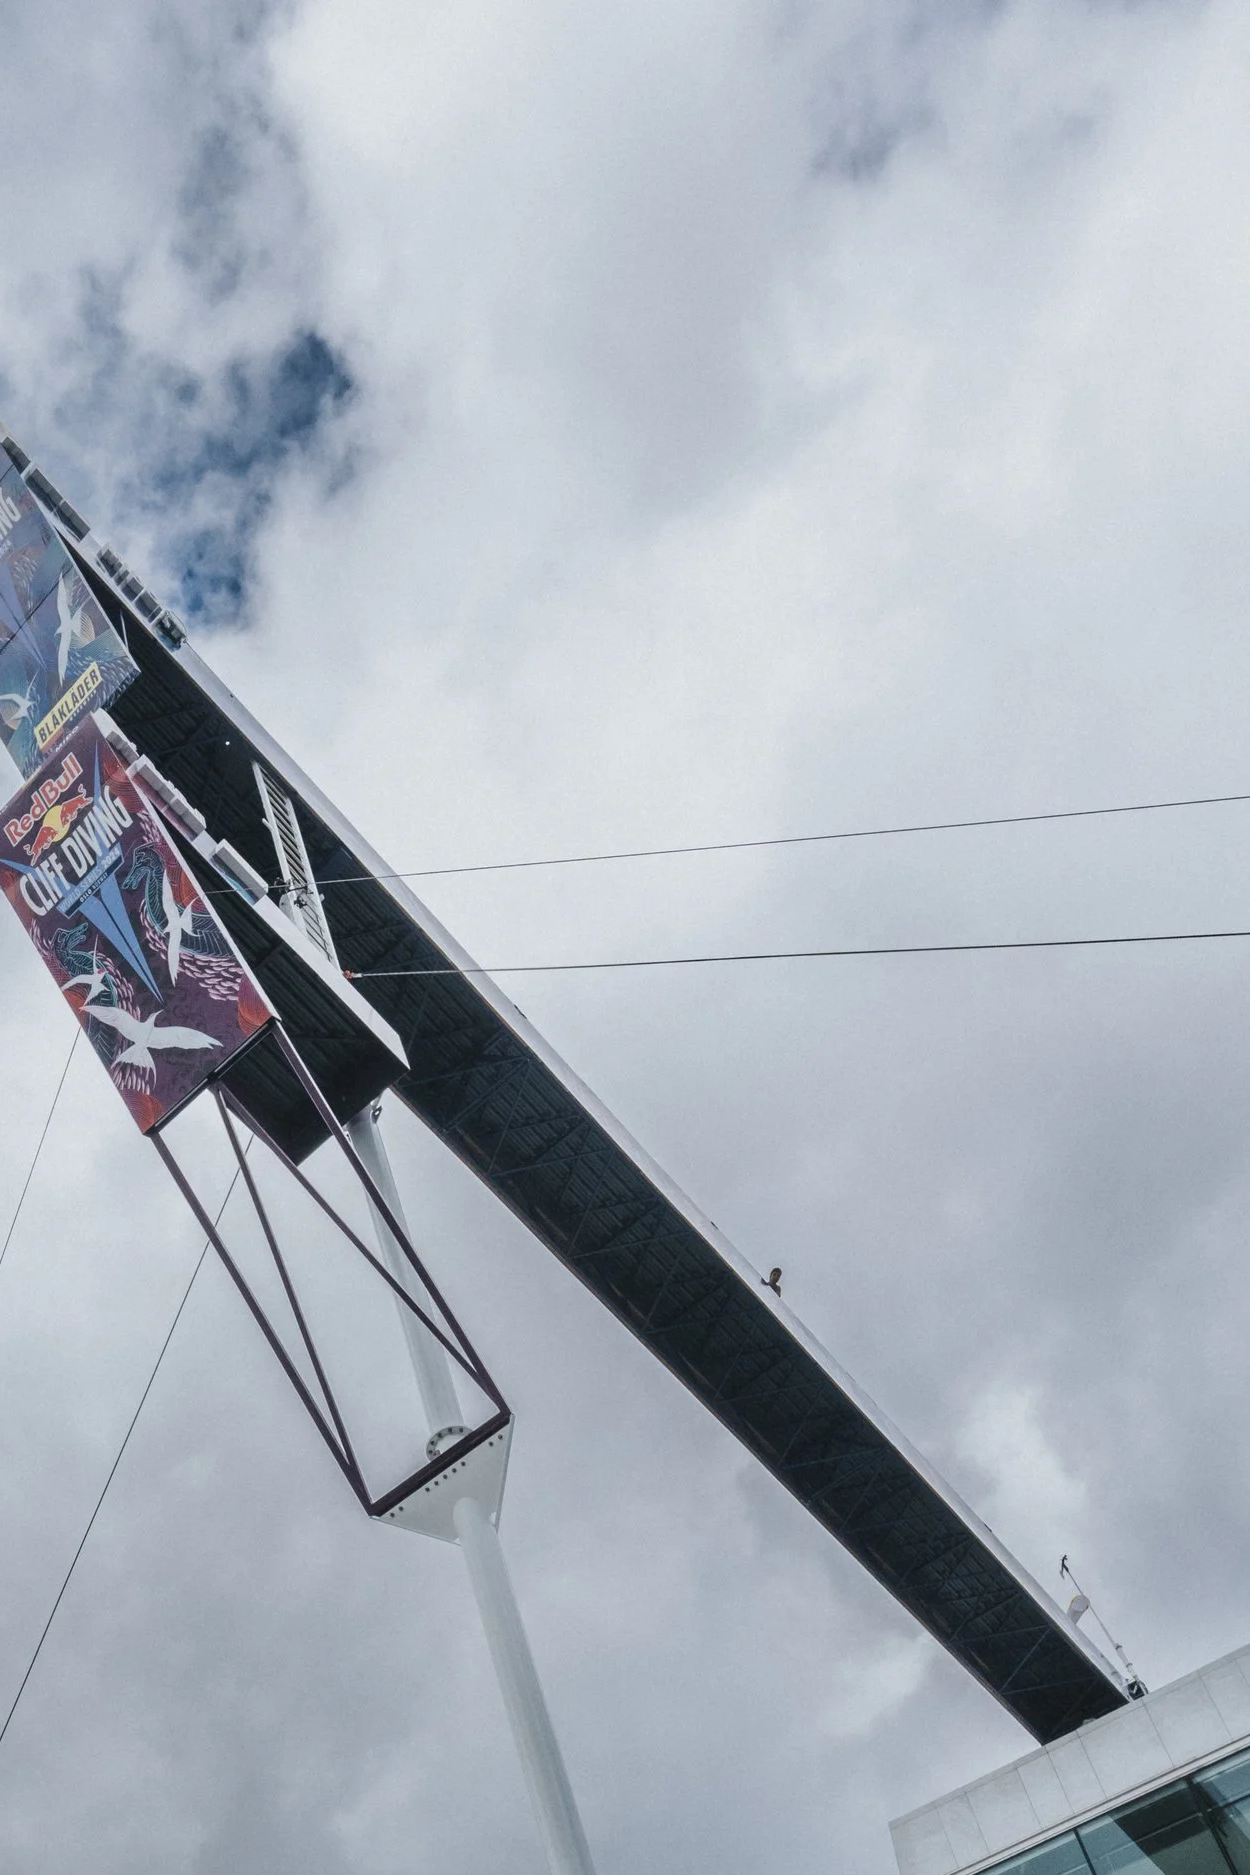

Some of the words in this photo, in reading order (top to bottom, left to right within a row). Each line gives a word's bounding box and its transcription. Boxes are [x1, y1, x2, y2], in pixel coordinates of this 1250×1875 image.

[3, 791, 47, 847] Red
[39, 752, 83, 807] Bull
[20, 852, 70, 916] CLIFF
[61, 785, 133, 878] DIVING
[102, 847, 120, 868] 2024
